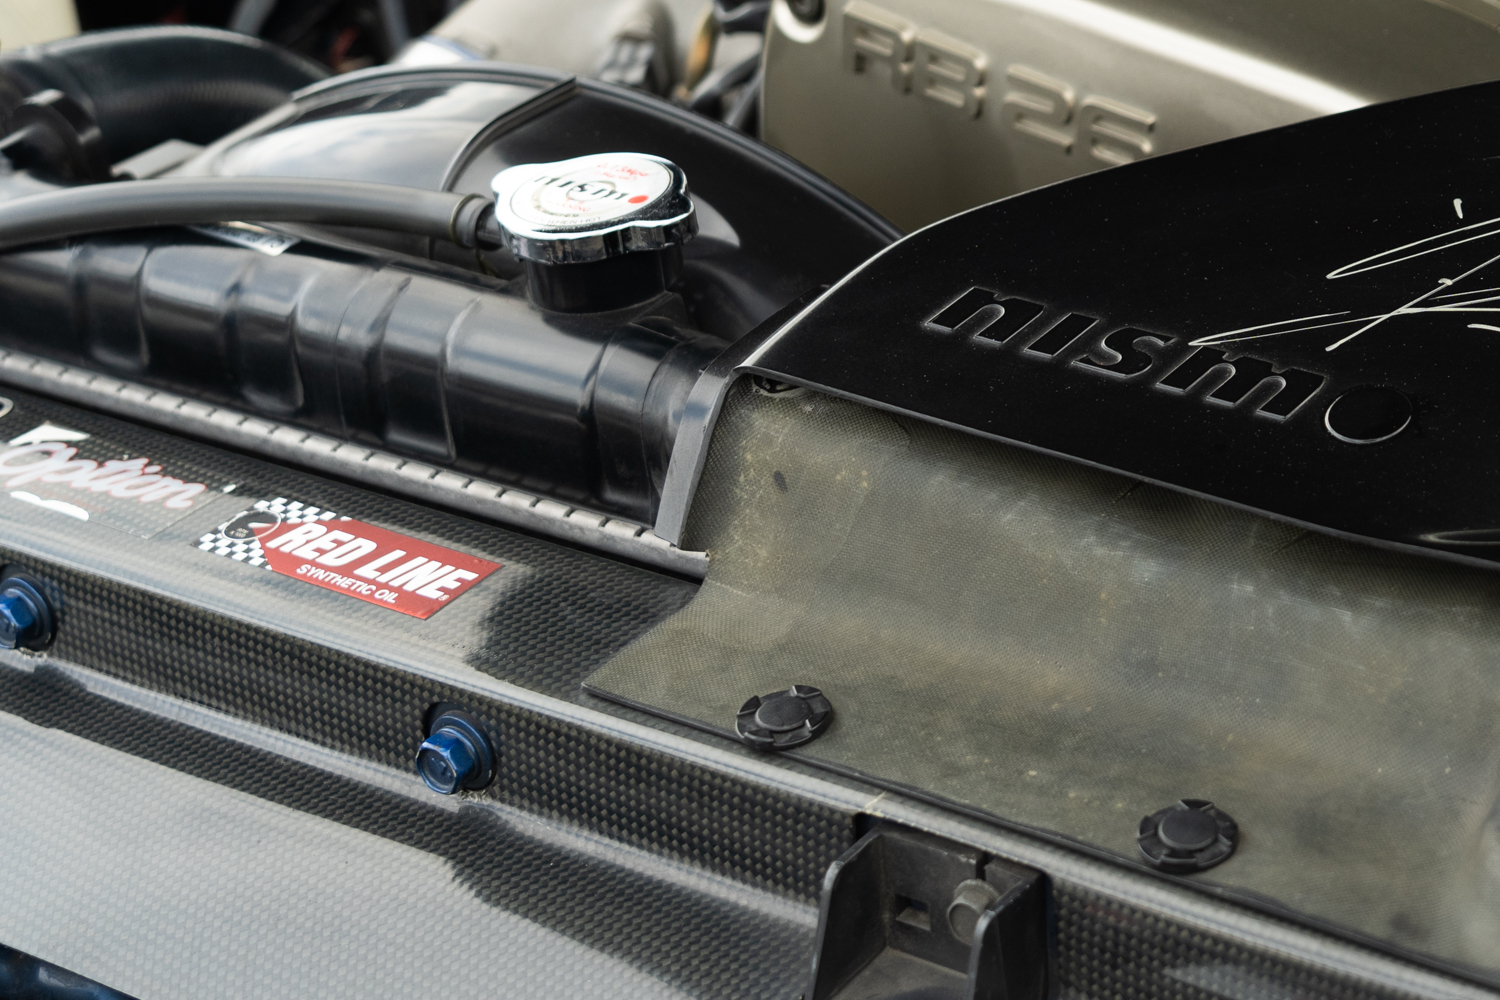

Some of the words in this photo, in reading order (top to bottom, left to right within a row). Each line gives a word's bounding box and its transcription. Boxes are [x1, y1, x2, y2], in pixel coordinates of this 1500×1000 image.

[921, 284, 1413, 444] nismo
[0, 442, 207, 509] Option
[265, 522, 377, 567] RED
[353, 549, 479, 600] LINE
[296, 564, 372, 596] SYNTHETIC
[373, 588, 398, 604] OIL
